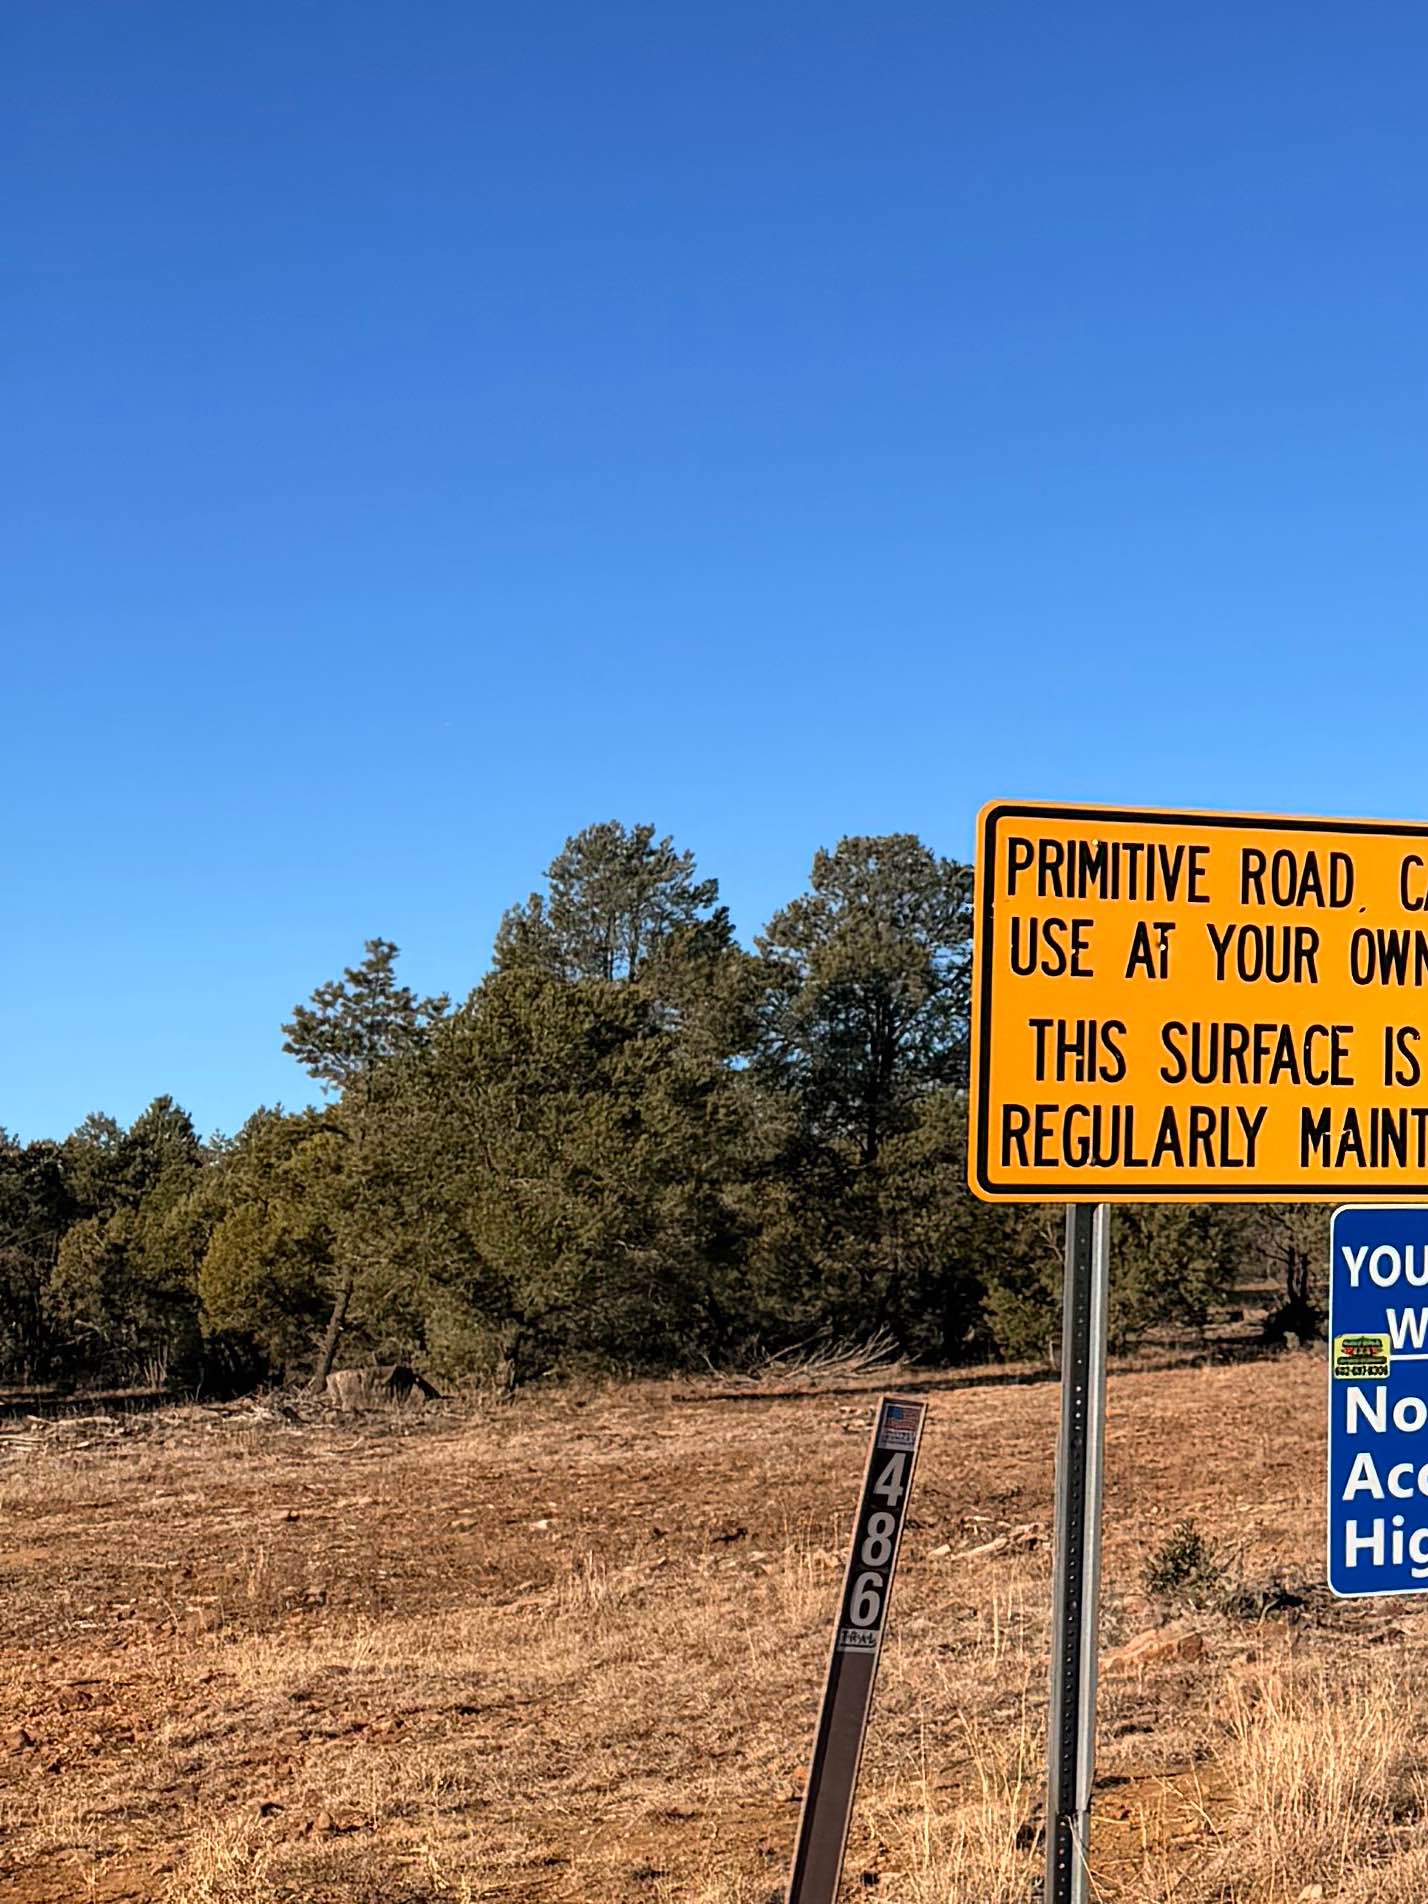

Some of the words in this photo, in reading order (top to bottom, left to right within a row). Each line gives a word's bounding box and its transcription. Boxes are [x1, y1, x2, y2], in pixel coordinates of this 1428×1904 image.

[1008, 837, 1209, 902] PRIMITIVE
[1011, 917, 1093, 977] USE
[1126, 921, 1175, 978] AT
[1207, 924, 1319, 983] YOUR
[1029, 1019, 1126, 1082] THIS
[1161, 1022, 1353, 1085] SURFACE
[1385, 1027, 1420, 1086] IS
[1002, 1104, 1267, 1167] REGULARLY
[1346, 1386, 1427, 1433] No
[849, 1452, 907, 1627] 486
